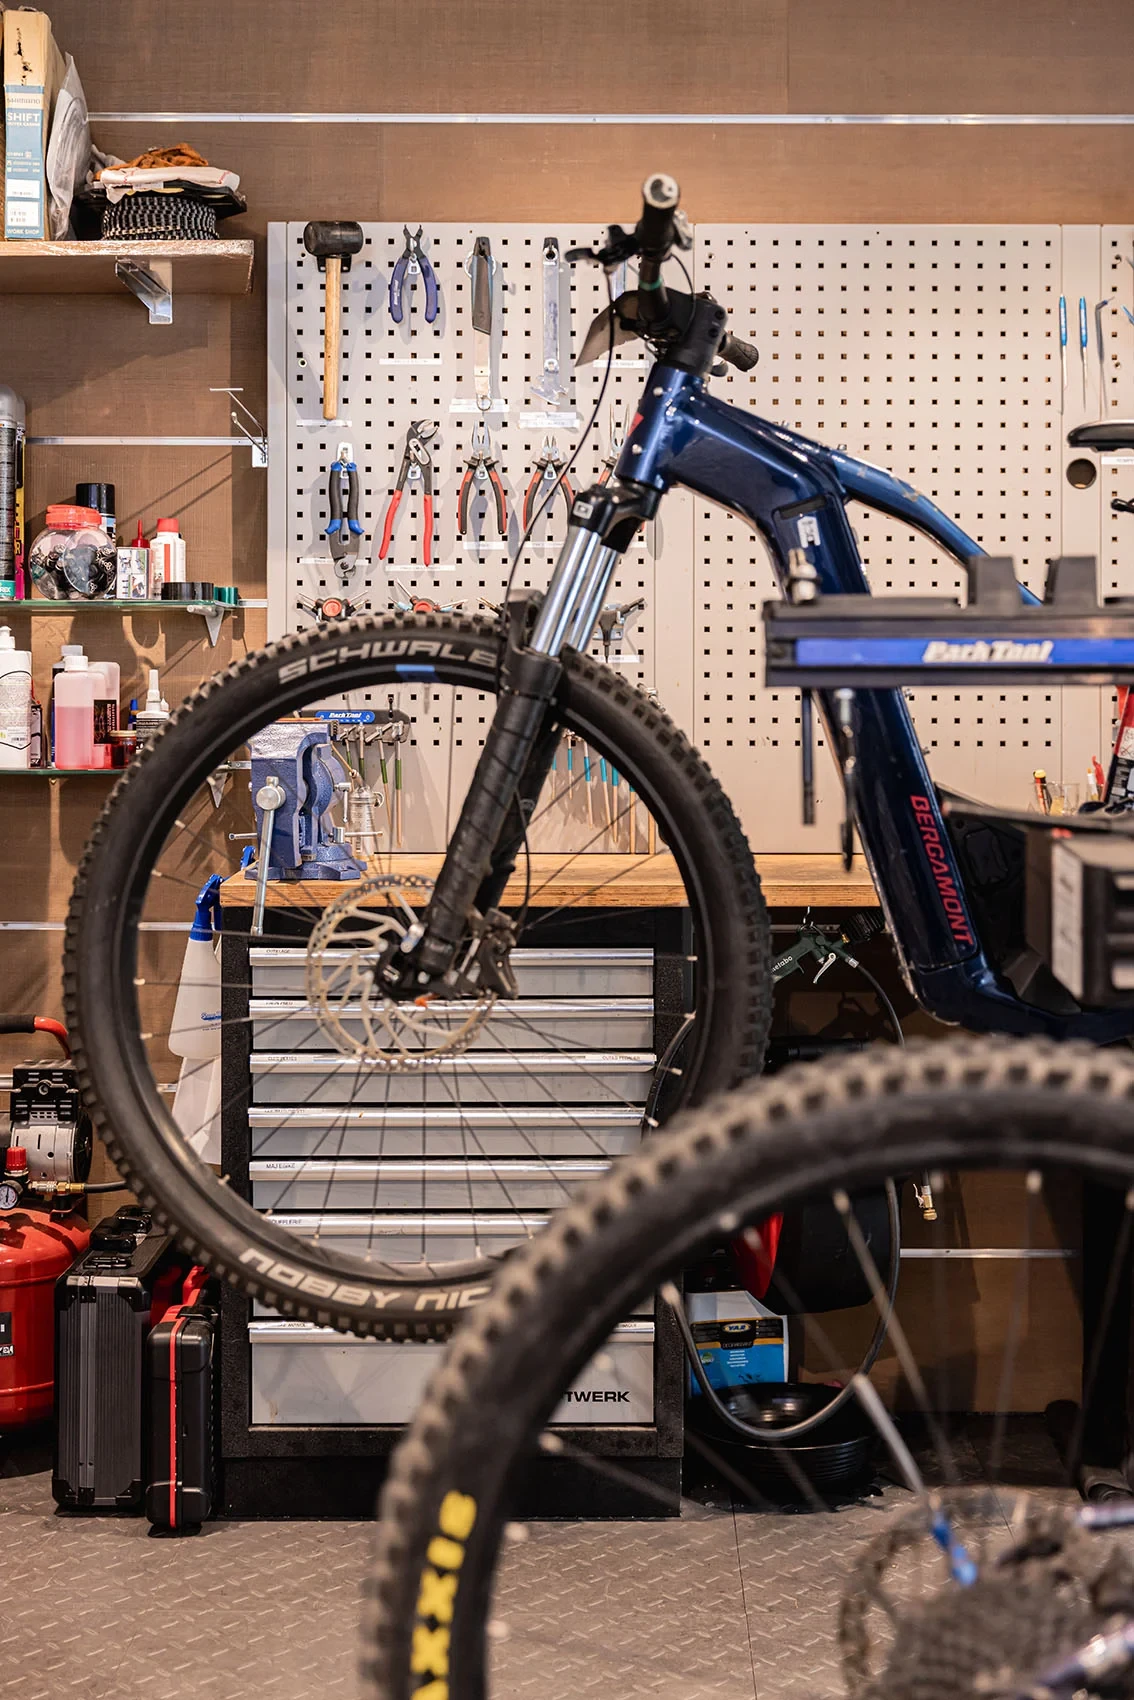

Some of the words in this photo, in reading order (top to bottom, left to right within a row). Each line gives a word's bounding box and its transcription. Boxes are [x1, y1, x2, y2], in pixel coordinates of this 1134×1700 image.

[7, 112, 41, 122] SHIFT
[910, 794, 974, 946] BERGAMONT
[239, 1248, 400, 1309] NOBBY
